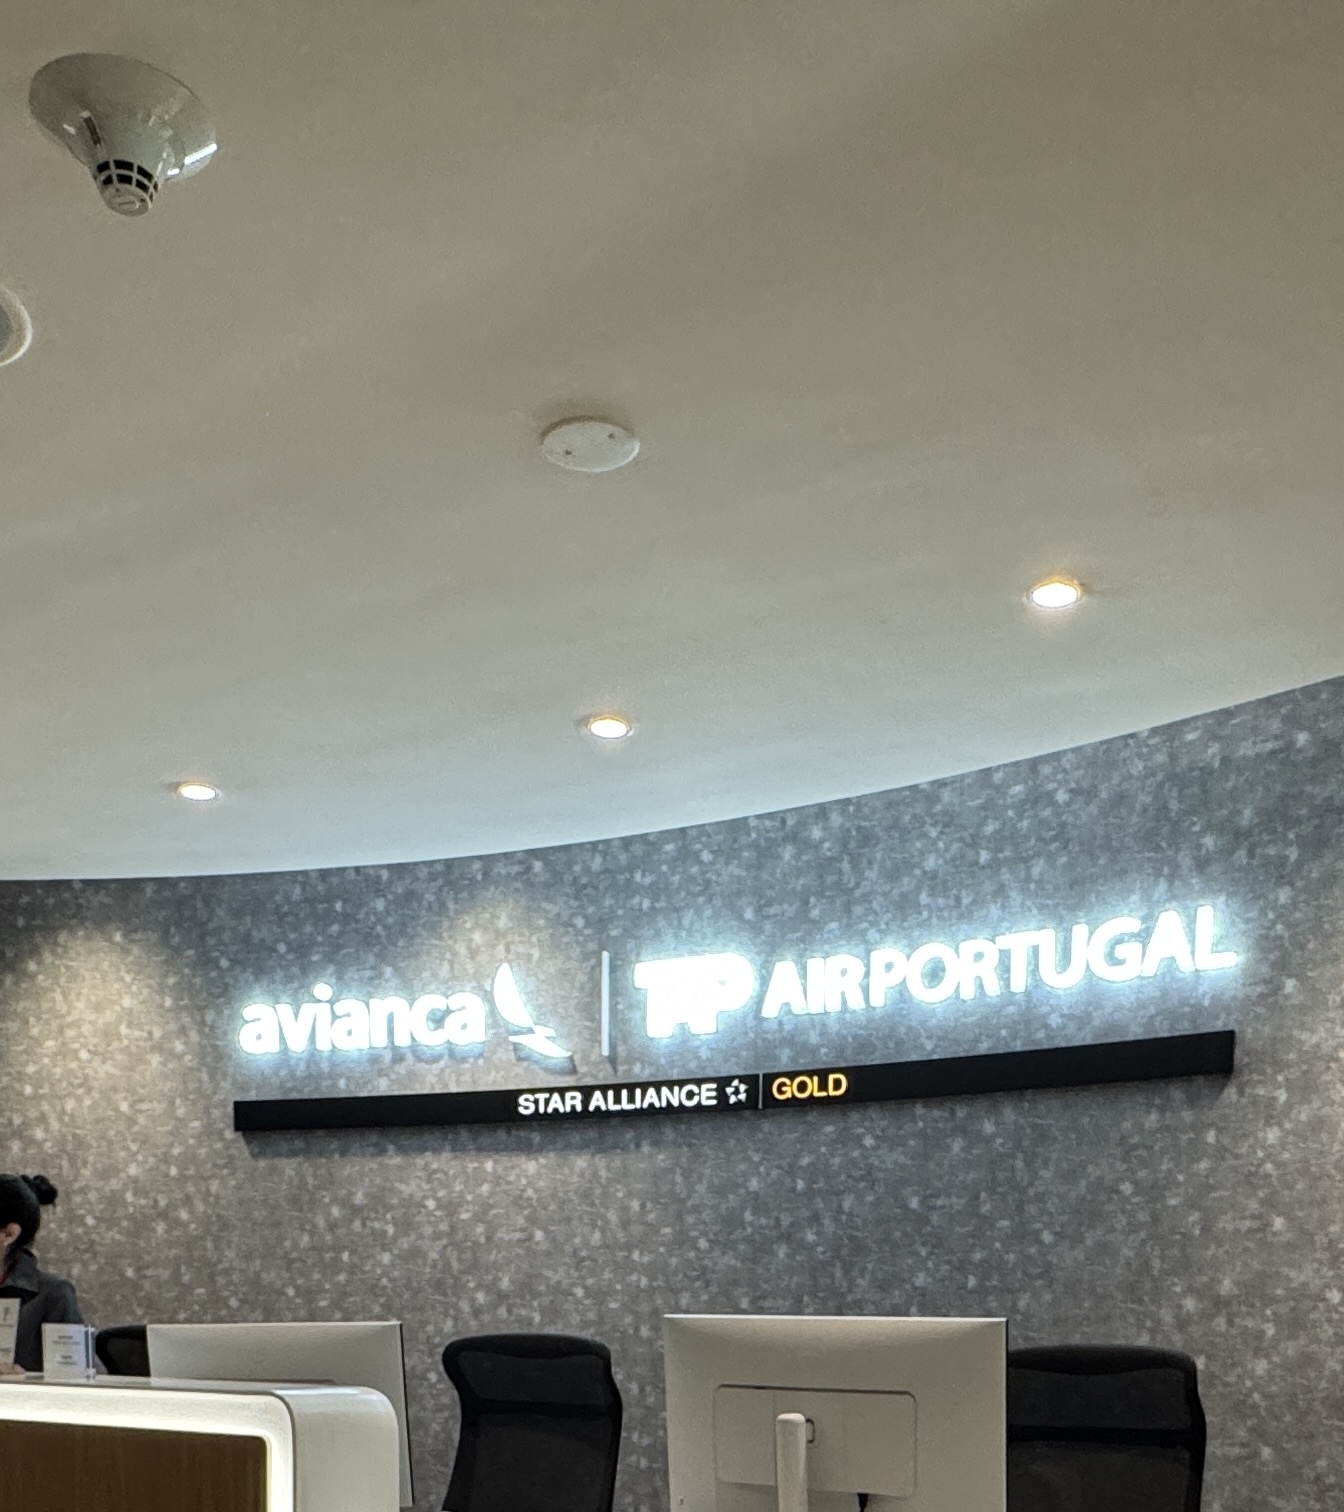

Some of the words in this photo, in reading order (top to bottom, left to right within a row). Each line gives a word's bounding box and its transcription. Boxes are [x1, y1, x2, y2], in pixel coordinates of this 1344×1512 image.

[238, 982, 486, 1055] avianca
[517, 1091, 583, 1115] STAR
[588, 1083, 718, 1112] ALLIANCE
[771, 1073, 849, 1101] GOLD
